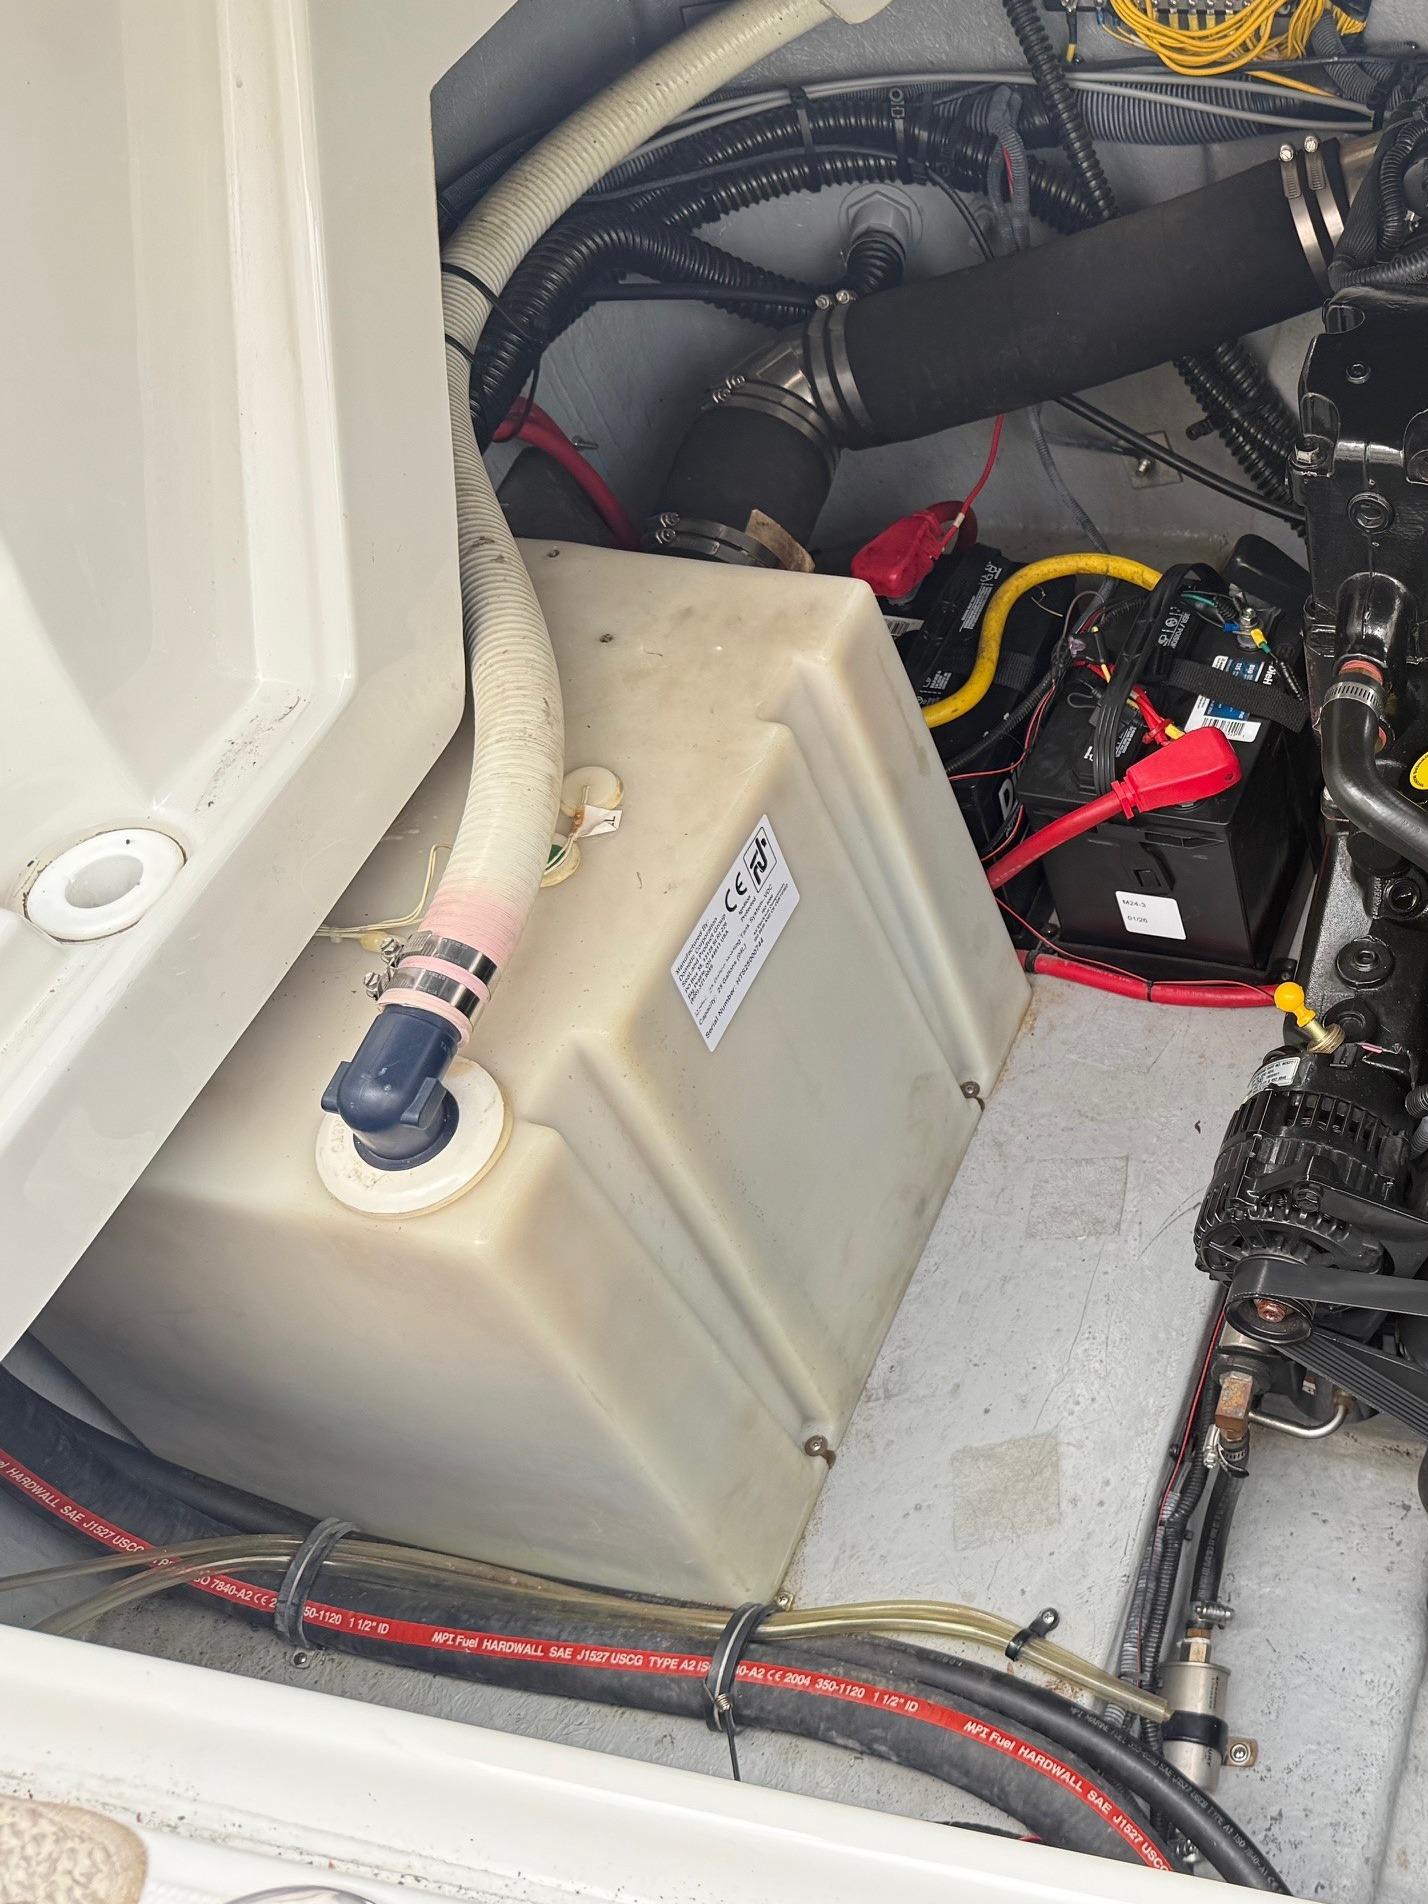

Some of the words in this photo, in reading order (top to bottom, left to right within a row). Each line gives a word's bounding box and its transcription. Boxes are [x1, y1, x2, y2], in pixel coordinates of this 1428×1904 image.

[704, 1014, 719, 1039] Serial
[6, 1466, 61, 1508] HARDWALL
[60, 1505, 86, 1523] SAE
[83, 1520, 114, 1541] J1527
[212, 1578, 252, 1600] 7840-A2
[303, 1606, 342, 1625] 50-1120
[349, 1618, 354, 1628] 1
[377, 1623, 389, 1635] ID
[431, 1631, 456, 1645] MPI
[455, 1635, 478, 1648] Fuel
[482, 1638, 544, 1656] HARDWALL
[549, 1646, 573, 1659] SAE
[577, 1649, 610, 1663] J1527
[610, 1652, 644, 1667] USCG
[649, 1656, 677, 1670] TYPE
[679, 1659, 695, 1671] A2
[736, 1663, 764, 1678] 0-A2
[784, 1672, 811, 1687] 2004
[815, 1676, 866, 1698] 350-1120
[872, 1691, 880, 1702] 1
[904, 1699, 919, 1712] ID
[963, 1720, 990, 1738] MPI
[988, 1731, 1016, 1751] Fuel
[1017, 1744, 1084, 1793] HARDWALL
[1087, 1790, 1113, 1815] SAE
[1112, 1814, 1144, 1843] J1527
